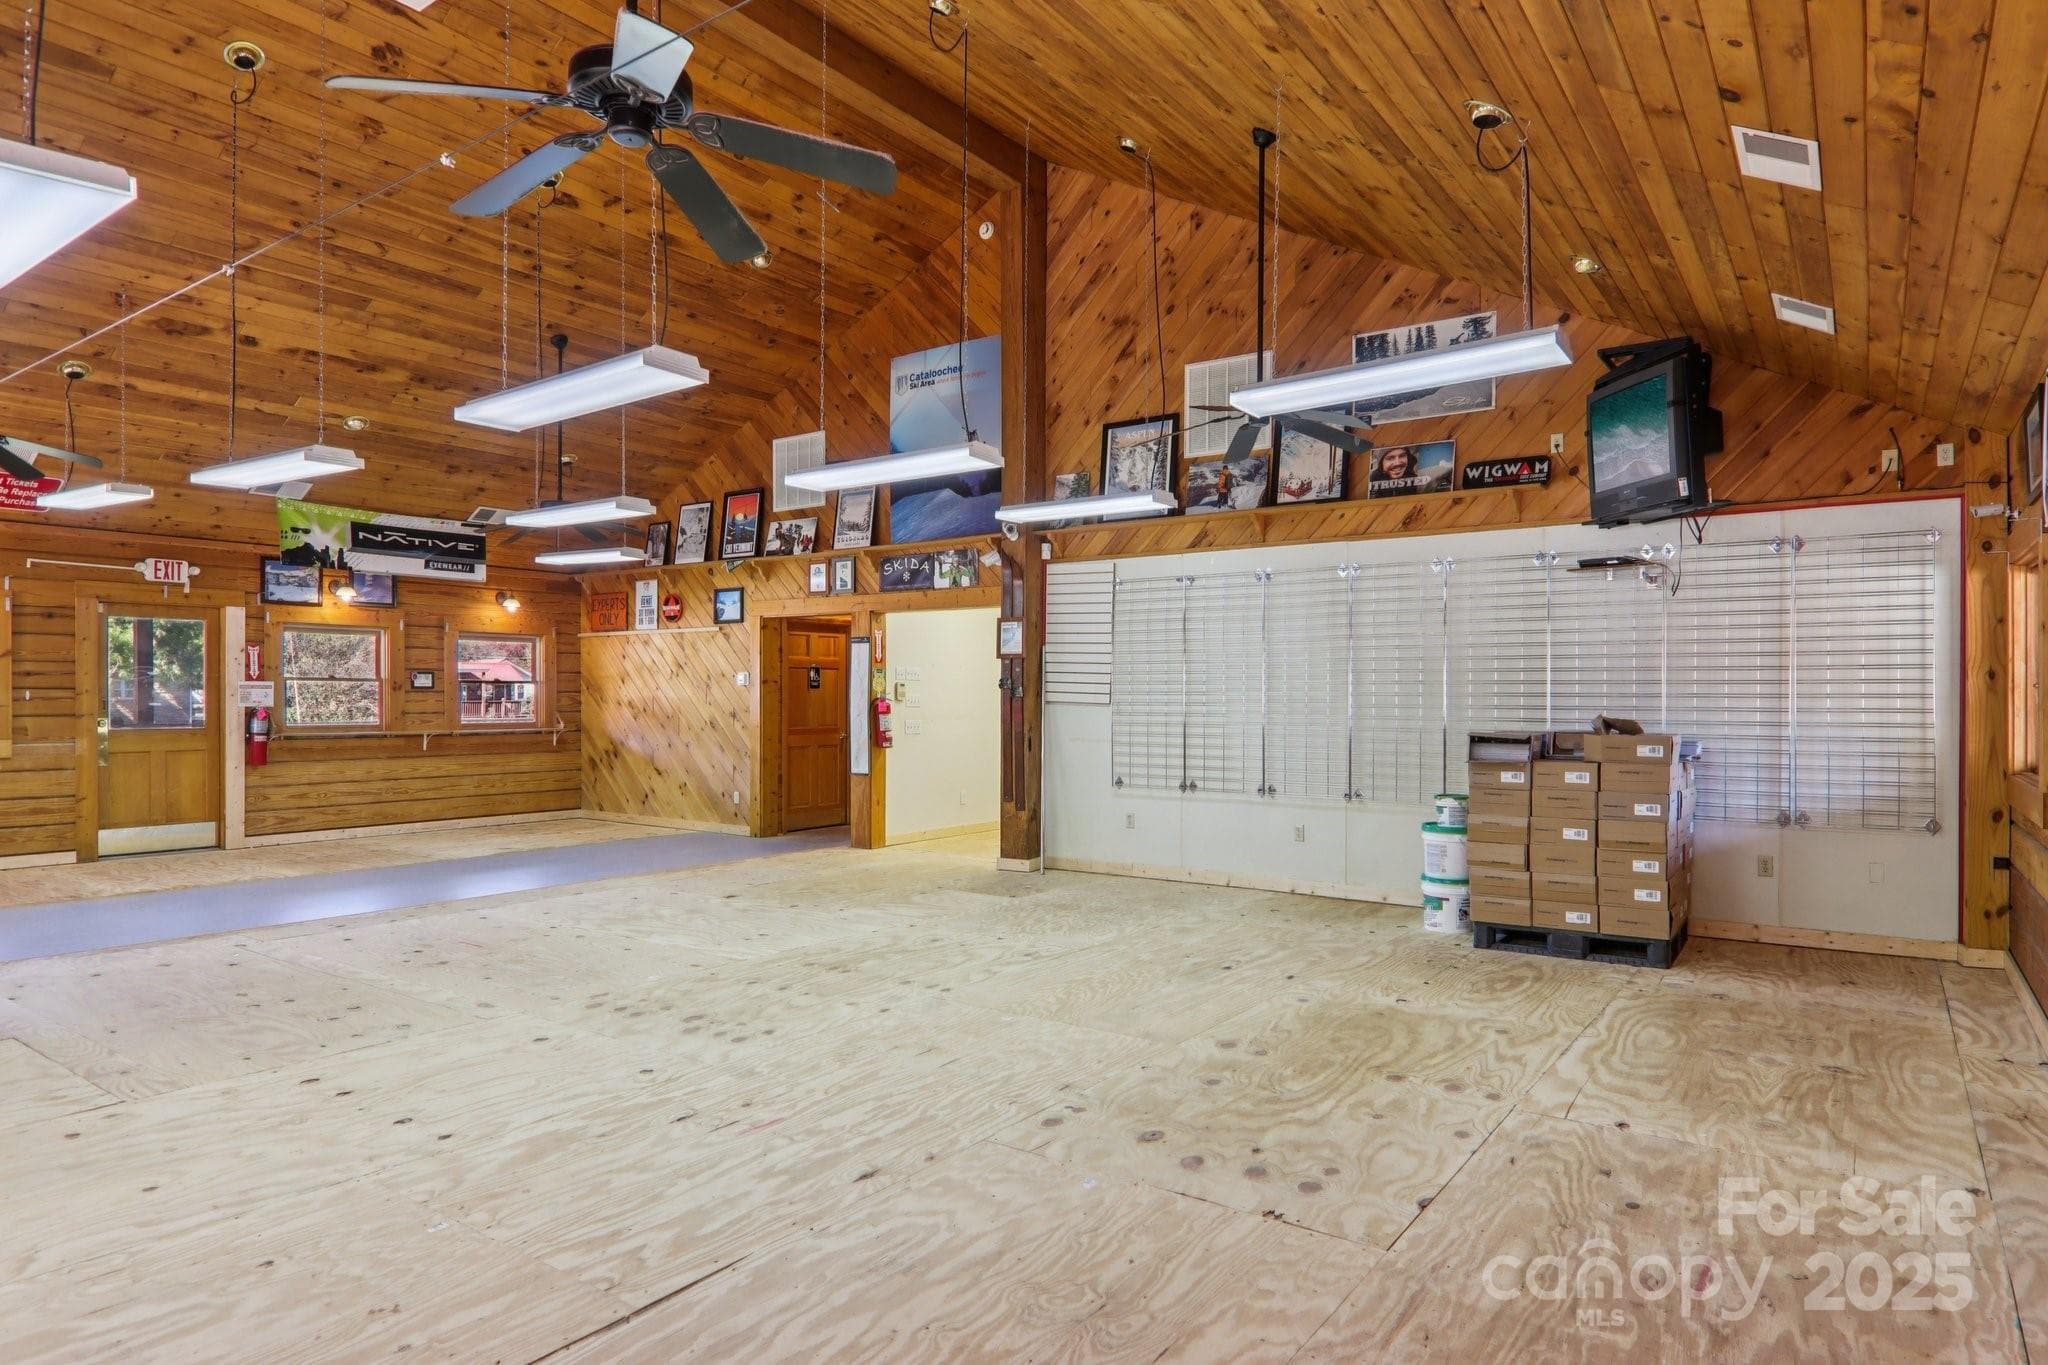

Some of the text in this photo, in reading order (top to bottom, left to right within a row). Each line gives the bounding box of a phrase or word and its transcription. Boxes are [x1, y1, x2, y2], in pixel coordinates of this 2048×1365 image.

[909, 379, 935, 390] Ski Area
[1466, 460, 1548, 479] WIGWAM
[6, 478, 39, 488] Tickets
[154, 560, 183, 581] EXIT
[883, 557, 930, 576] SKIDA
[599, 612, 619, 626] ONLY
